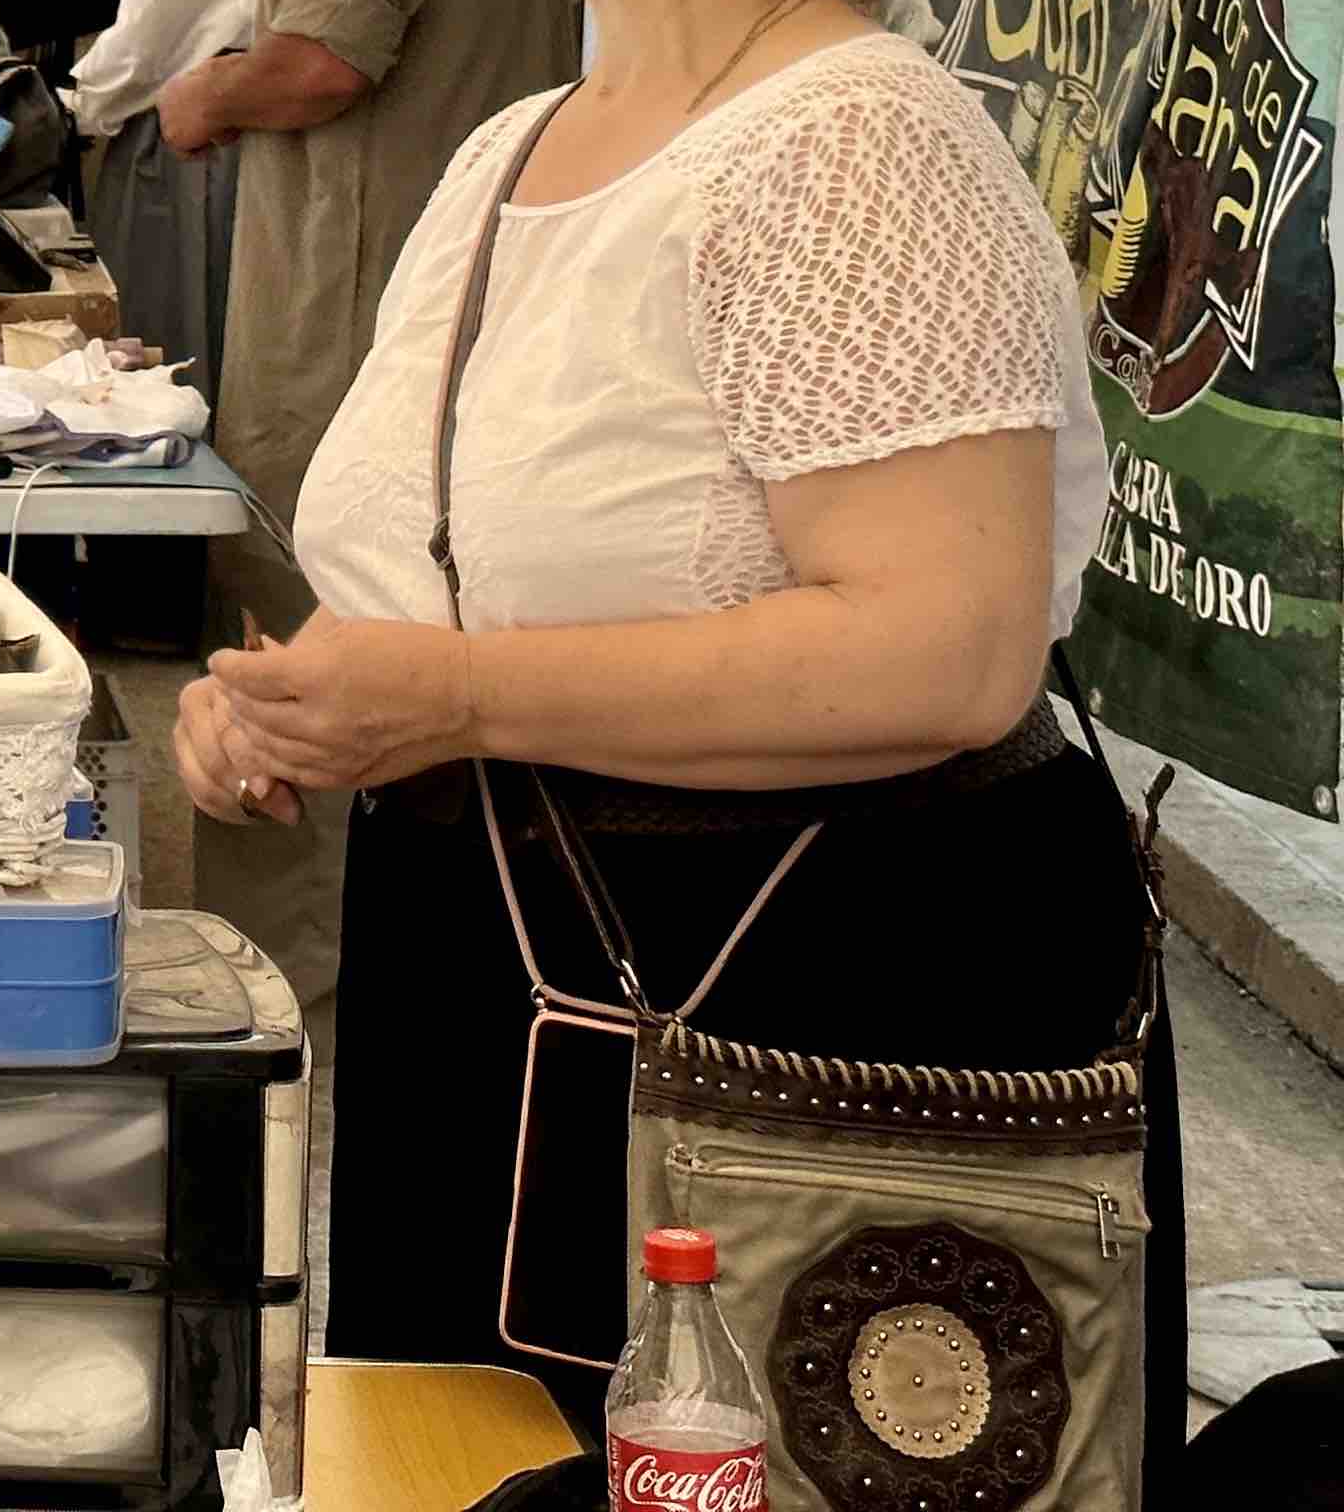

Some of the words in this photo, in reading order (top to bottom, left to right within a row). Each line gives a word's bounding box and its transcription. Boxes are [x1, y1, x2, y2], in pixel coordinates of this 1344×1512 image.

[1242, 59, 1283, 150] de
[1149, 531, 1187, 608] DE
[1194, 555, 1273, 638] ORO
[623, 1453, 764, 1512] Coca-Cola
